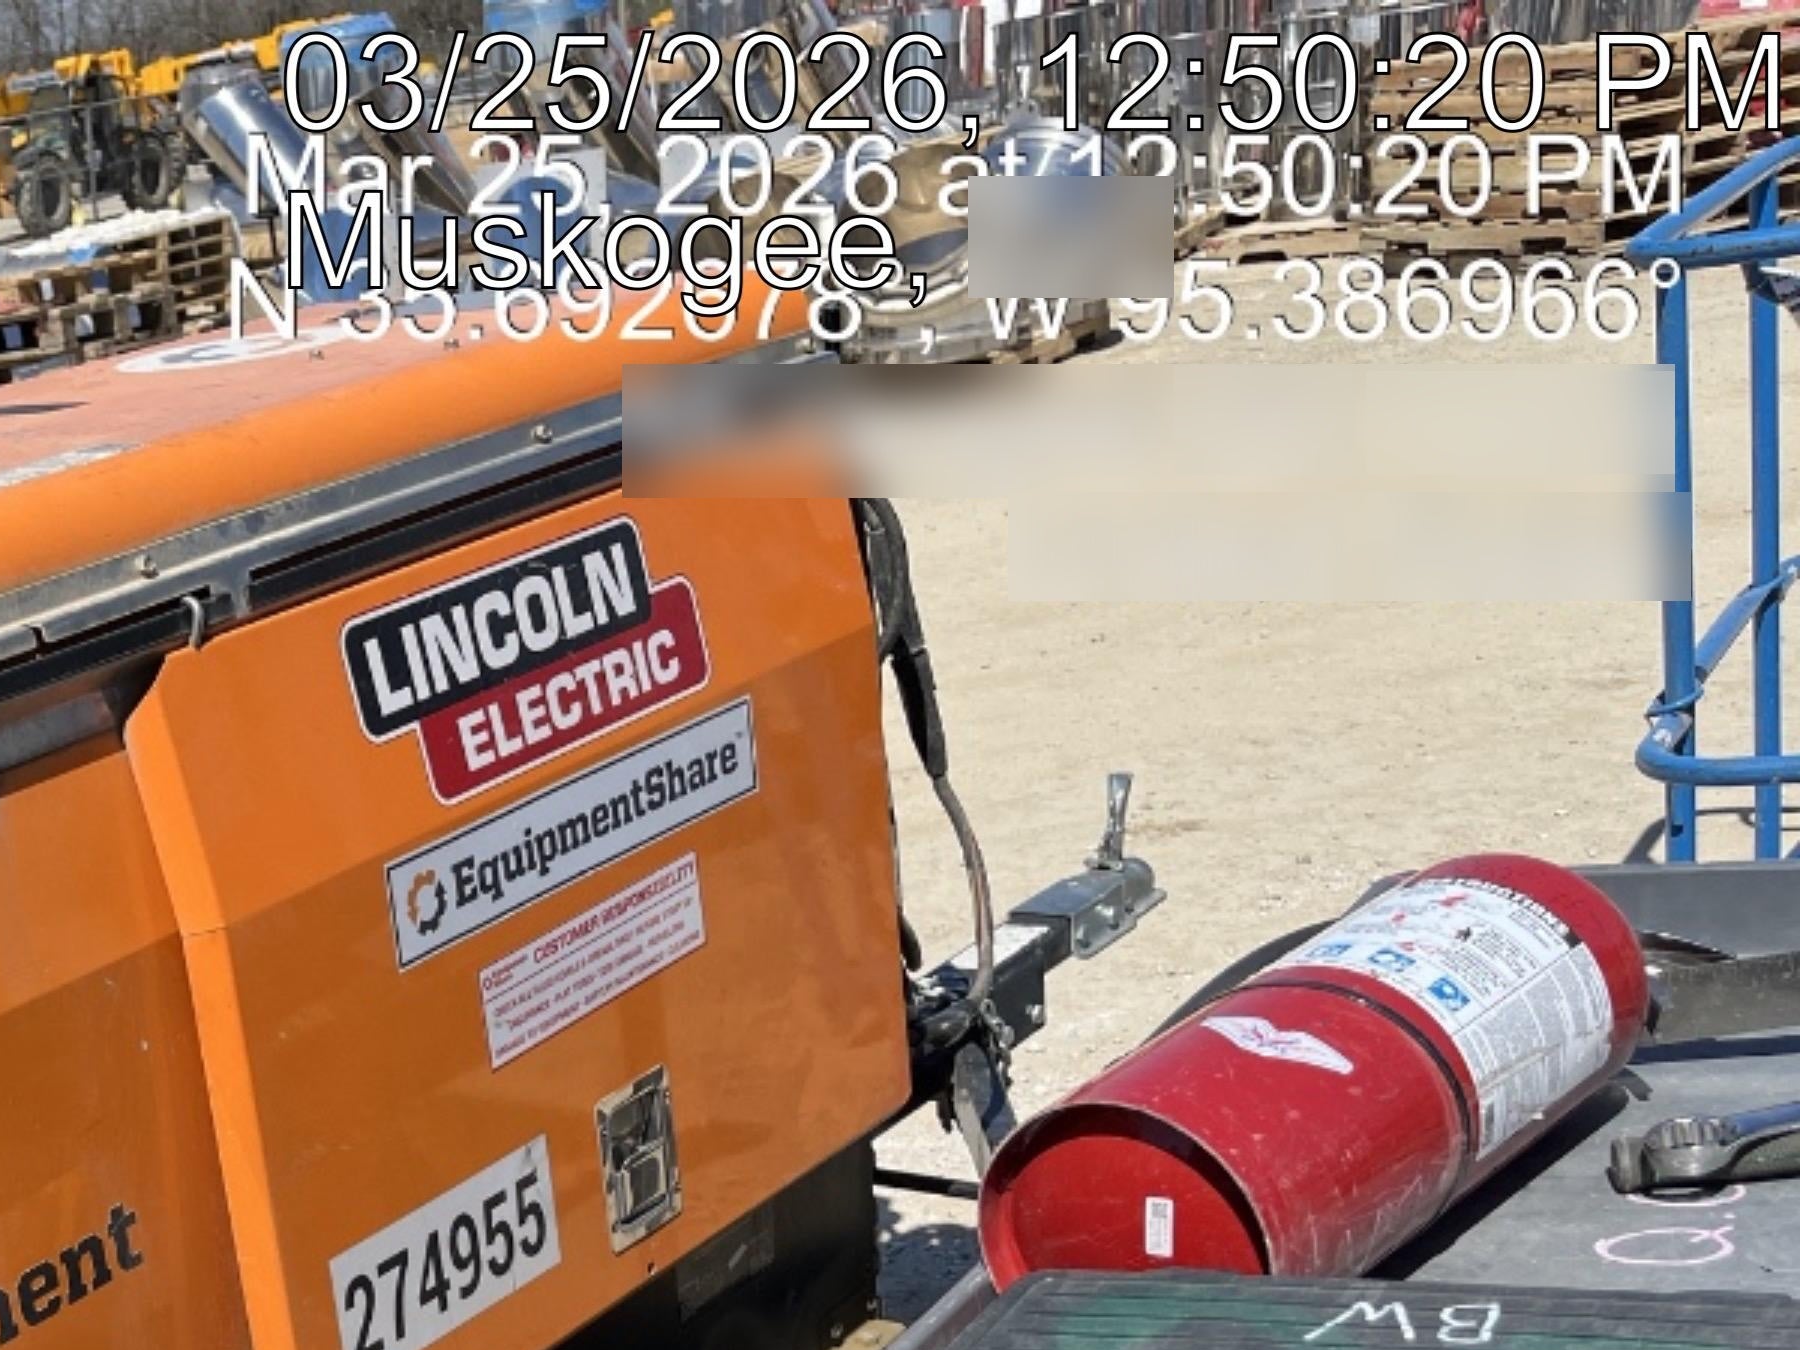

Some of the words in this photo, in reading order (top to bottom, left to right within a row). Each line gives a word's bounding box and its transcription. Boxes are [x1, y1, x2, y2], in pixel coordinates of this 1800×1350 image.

[362, 541, 638, 718] LINCOLN
[456, 628, 682, 772] ELECTRIC
[451, 740, 740, 909] EquipmentShare
